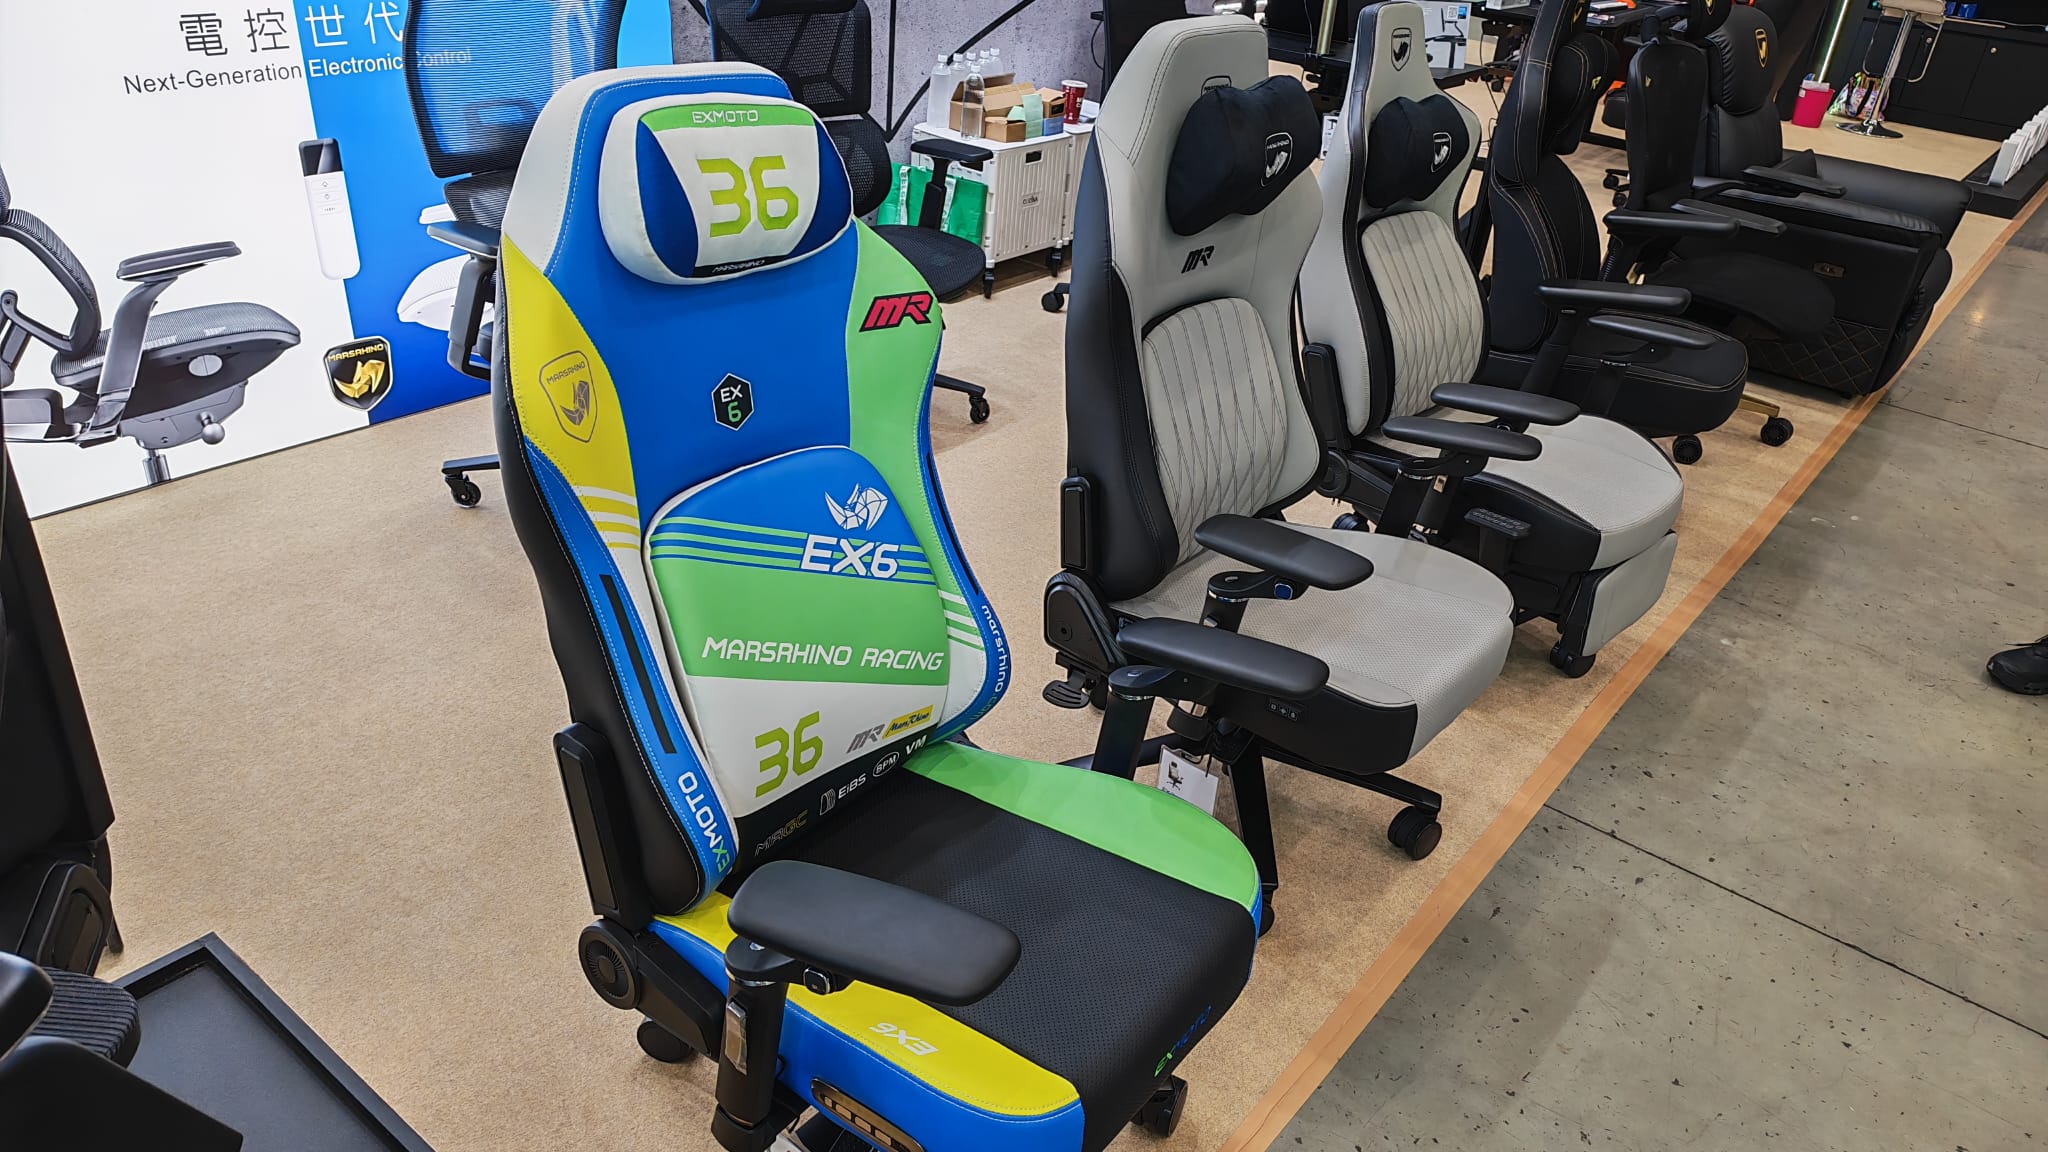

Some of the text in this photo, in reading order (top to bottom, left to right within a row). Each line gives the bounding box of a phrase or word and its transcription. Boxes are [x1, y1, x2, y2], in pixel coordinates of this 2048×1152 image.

[179, 1, 403, 56] 電控世代
[123, 47, 473, 94] Next-Generation Electronic ontrol
[692, 110, 759, 124] EXMOTO
[696, 155, 799, 238] 36
[1181, 246, 1215, 274] MR
[859, 291, 933, 332] MR
[720, 384, 743, 403] EX
[727, 401, 742, 422] 6
[801, 534, 899, 578] EX6
[702, 637, 945, 671] MARSRHINO RACING
[755, 711, 823, 798] 36
[905, 735, 928, 755] VM
[678, 771, 731, 873] EXMOTO
[868, 1022, 939, 1056] EX6
